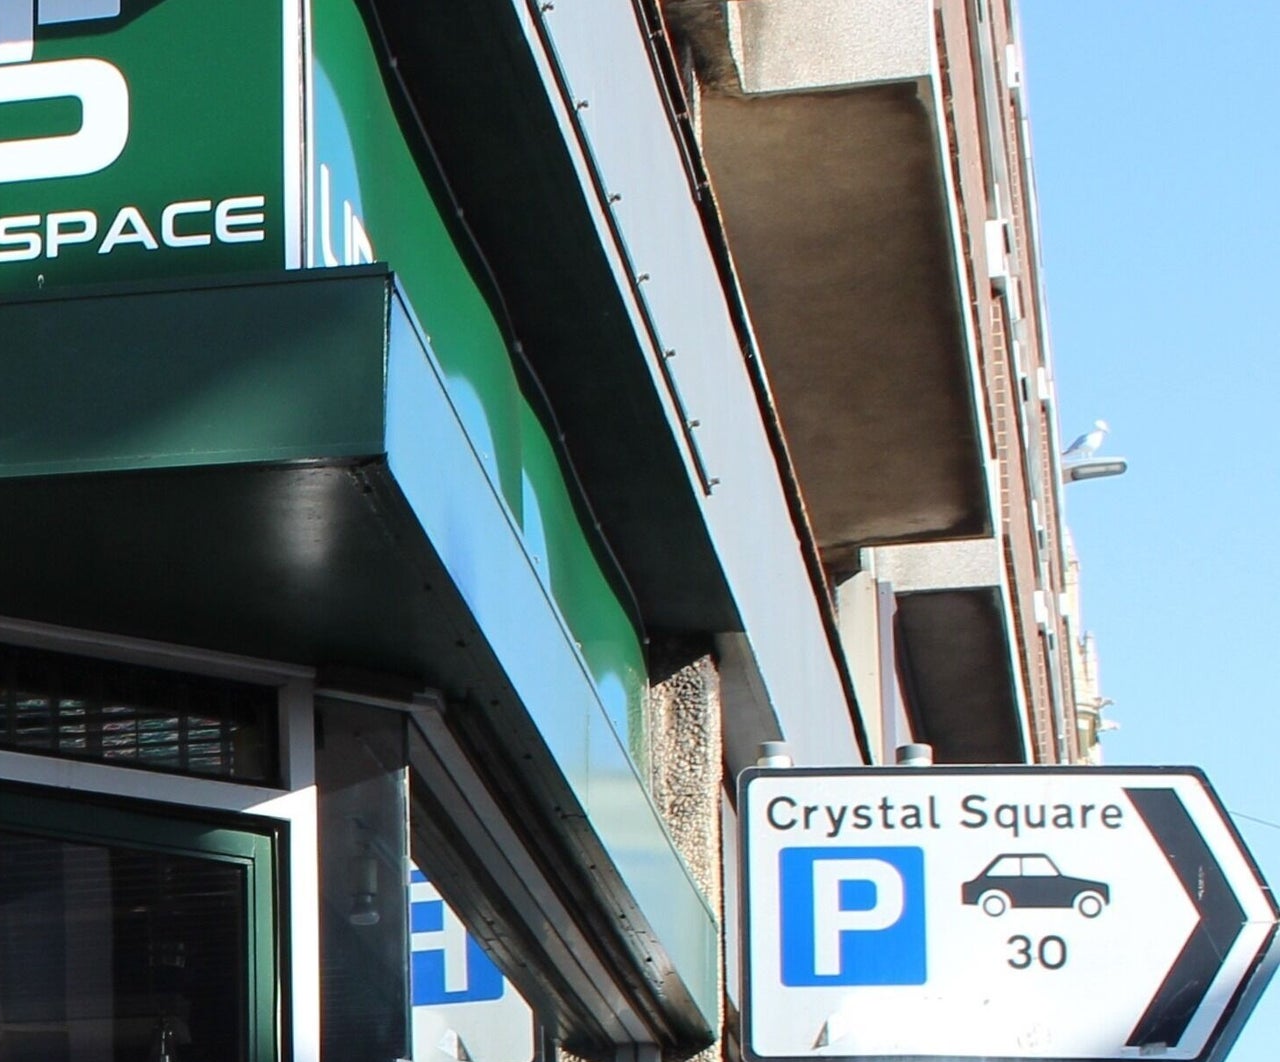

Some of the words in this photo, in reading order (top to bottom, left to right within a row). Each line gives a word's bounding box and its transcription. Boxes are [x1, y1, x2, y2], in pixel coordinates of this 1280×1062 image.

[766, 796, 941, 838] Crystal
[959, 794, 1124, 838] Square
[812, 857, 905, 976] P
[1006, 934, 1068, 970] 30
